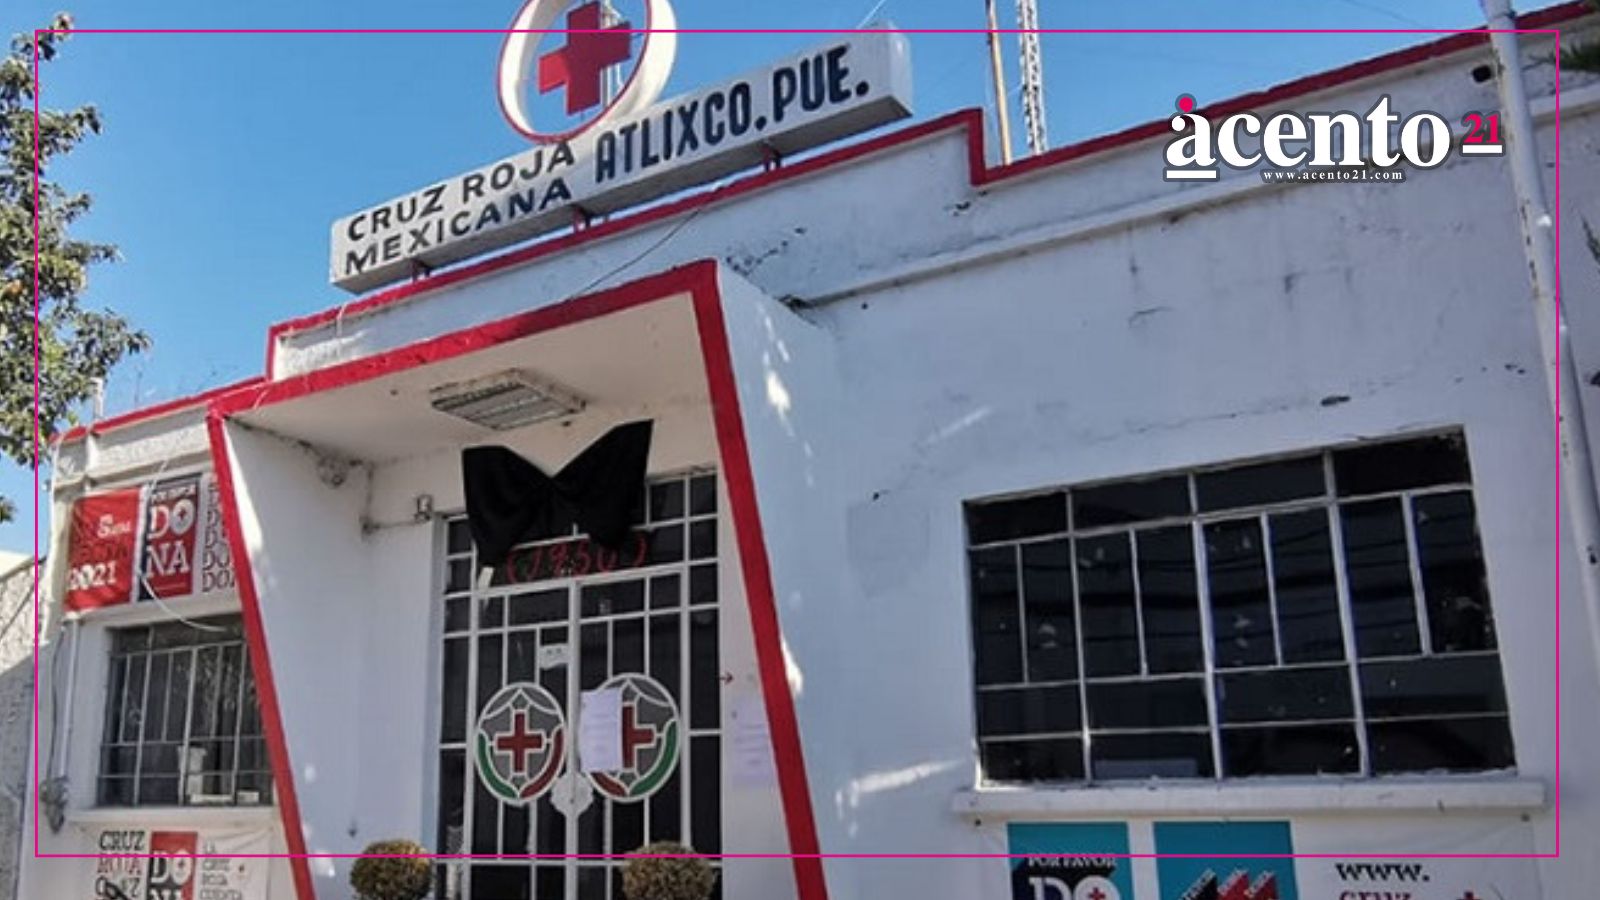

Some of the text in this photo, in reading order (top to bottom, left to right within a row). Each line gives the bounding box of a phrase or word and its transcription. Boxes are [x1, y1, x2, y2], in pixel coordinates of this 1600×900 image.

[347, 141, 576, 243] CRUZ ROJA
[344, 176, 573, 276] MEXICANA
[146, 541, 190, 578] NA
[99, 830, 145, 851] CRUZ
[1335, 862, 1431, 883] www.
